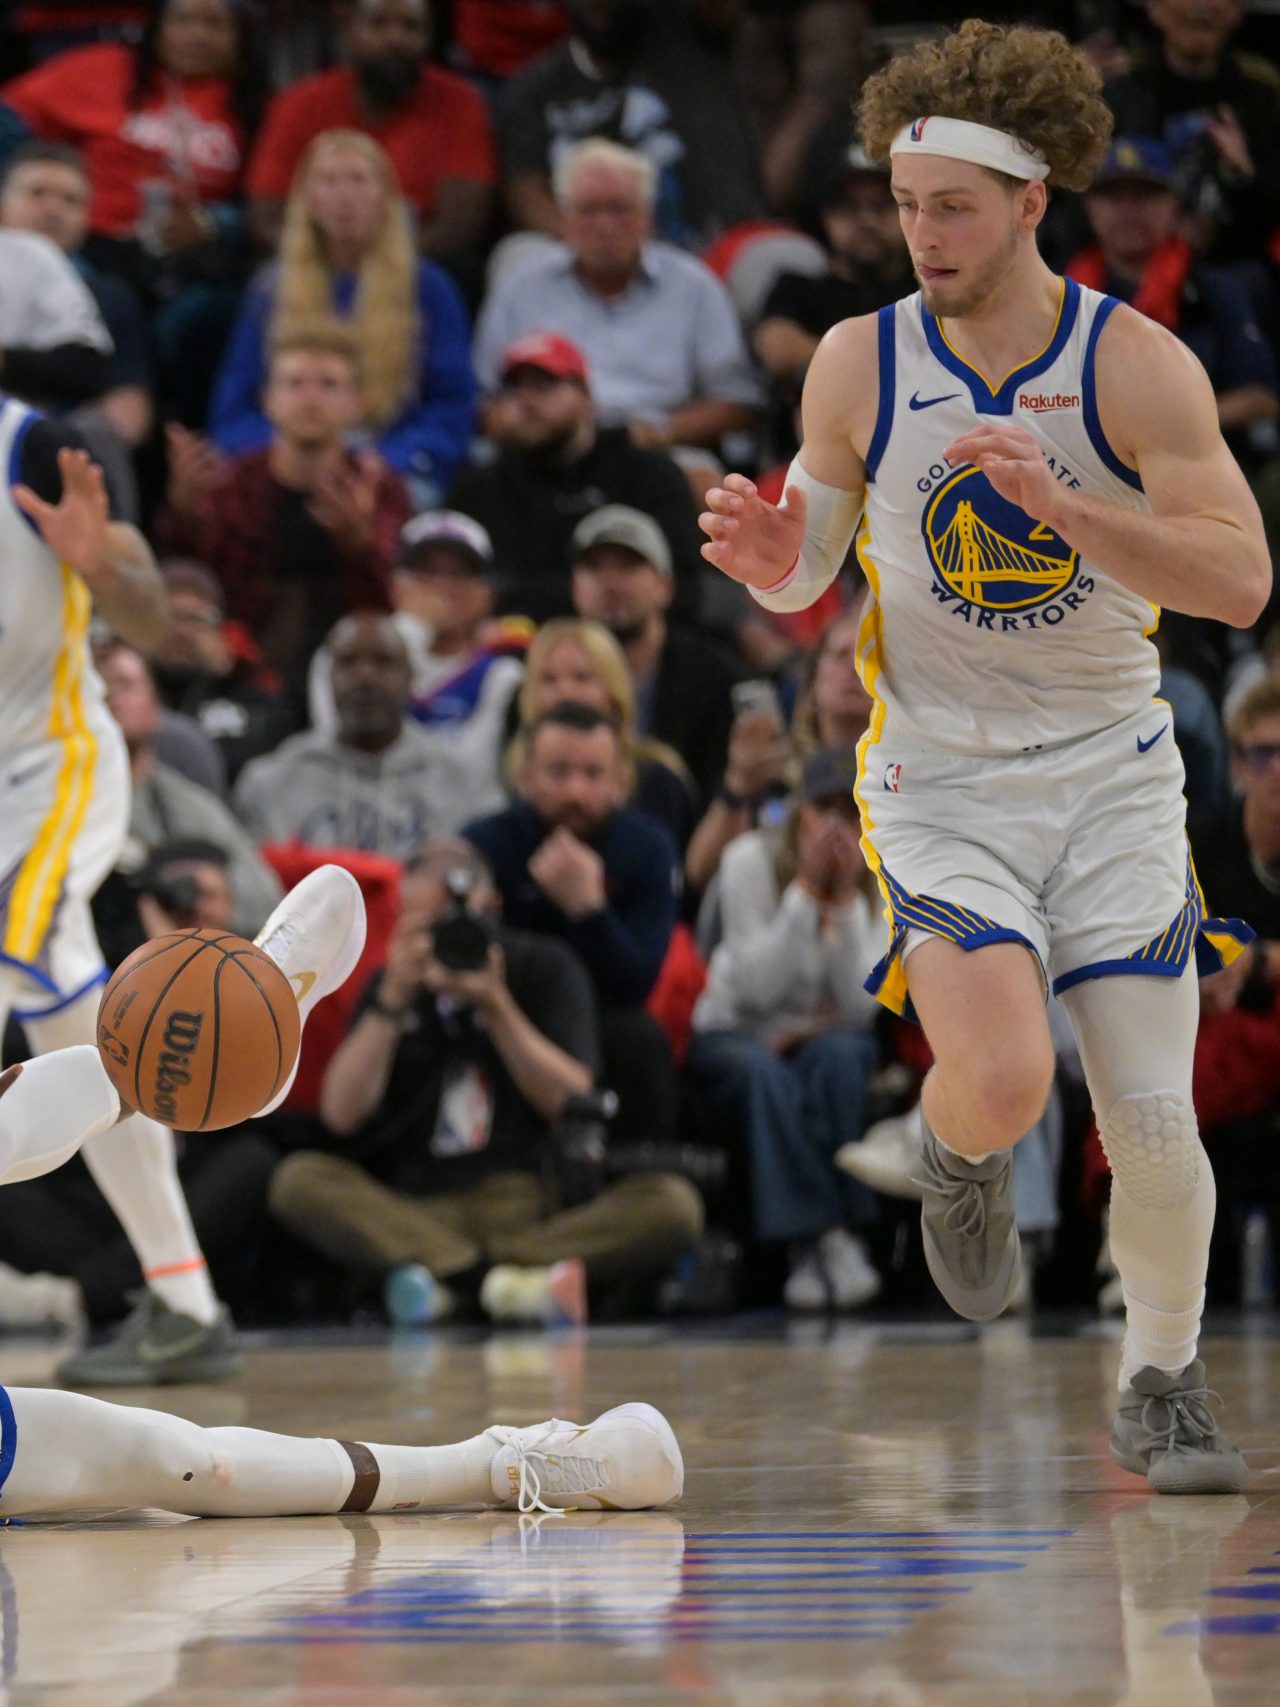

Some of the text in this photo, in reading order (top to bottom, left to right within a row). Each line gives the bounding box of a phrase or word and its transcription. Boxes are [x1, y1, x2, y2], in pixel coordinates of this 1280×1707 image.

[1019, 393, 1080, 409] Rakuten
[930, 575, 1095, 632] WARRIORS
[154, 1010, 204, 1124] Wilson
